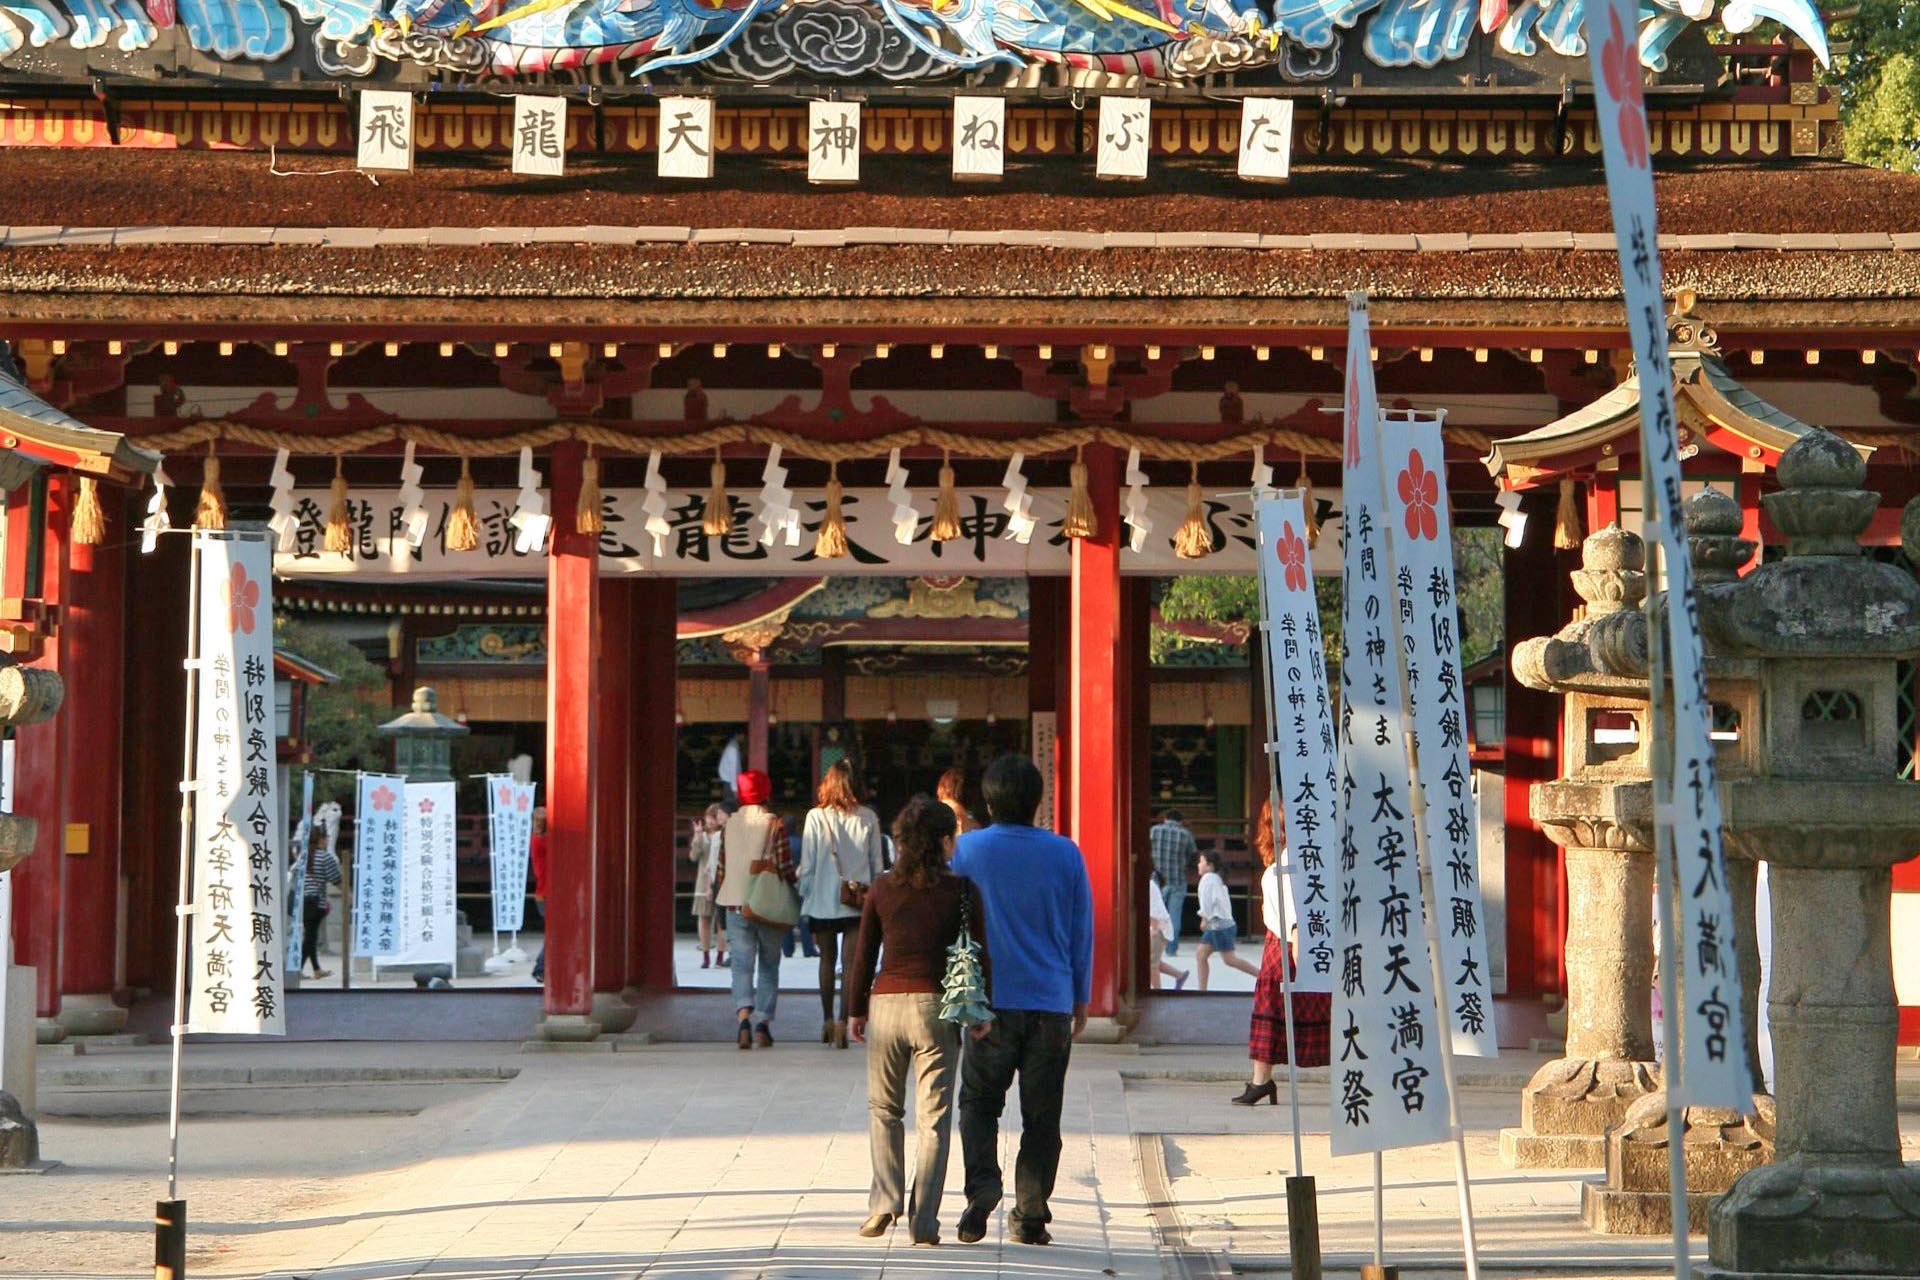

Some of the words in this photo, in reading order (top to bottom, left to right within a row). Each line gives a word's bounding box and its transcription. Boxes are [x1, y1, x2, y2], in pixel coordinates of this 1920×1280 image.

[366, 104, 1282, 161] 飛龍天神ねぶた
[1358, 504, 1392, 747] 学問の神さま
[1371, 771, 1430, 1115] 太宰府天満宮
